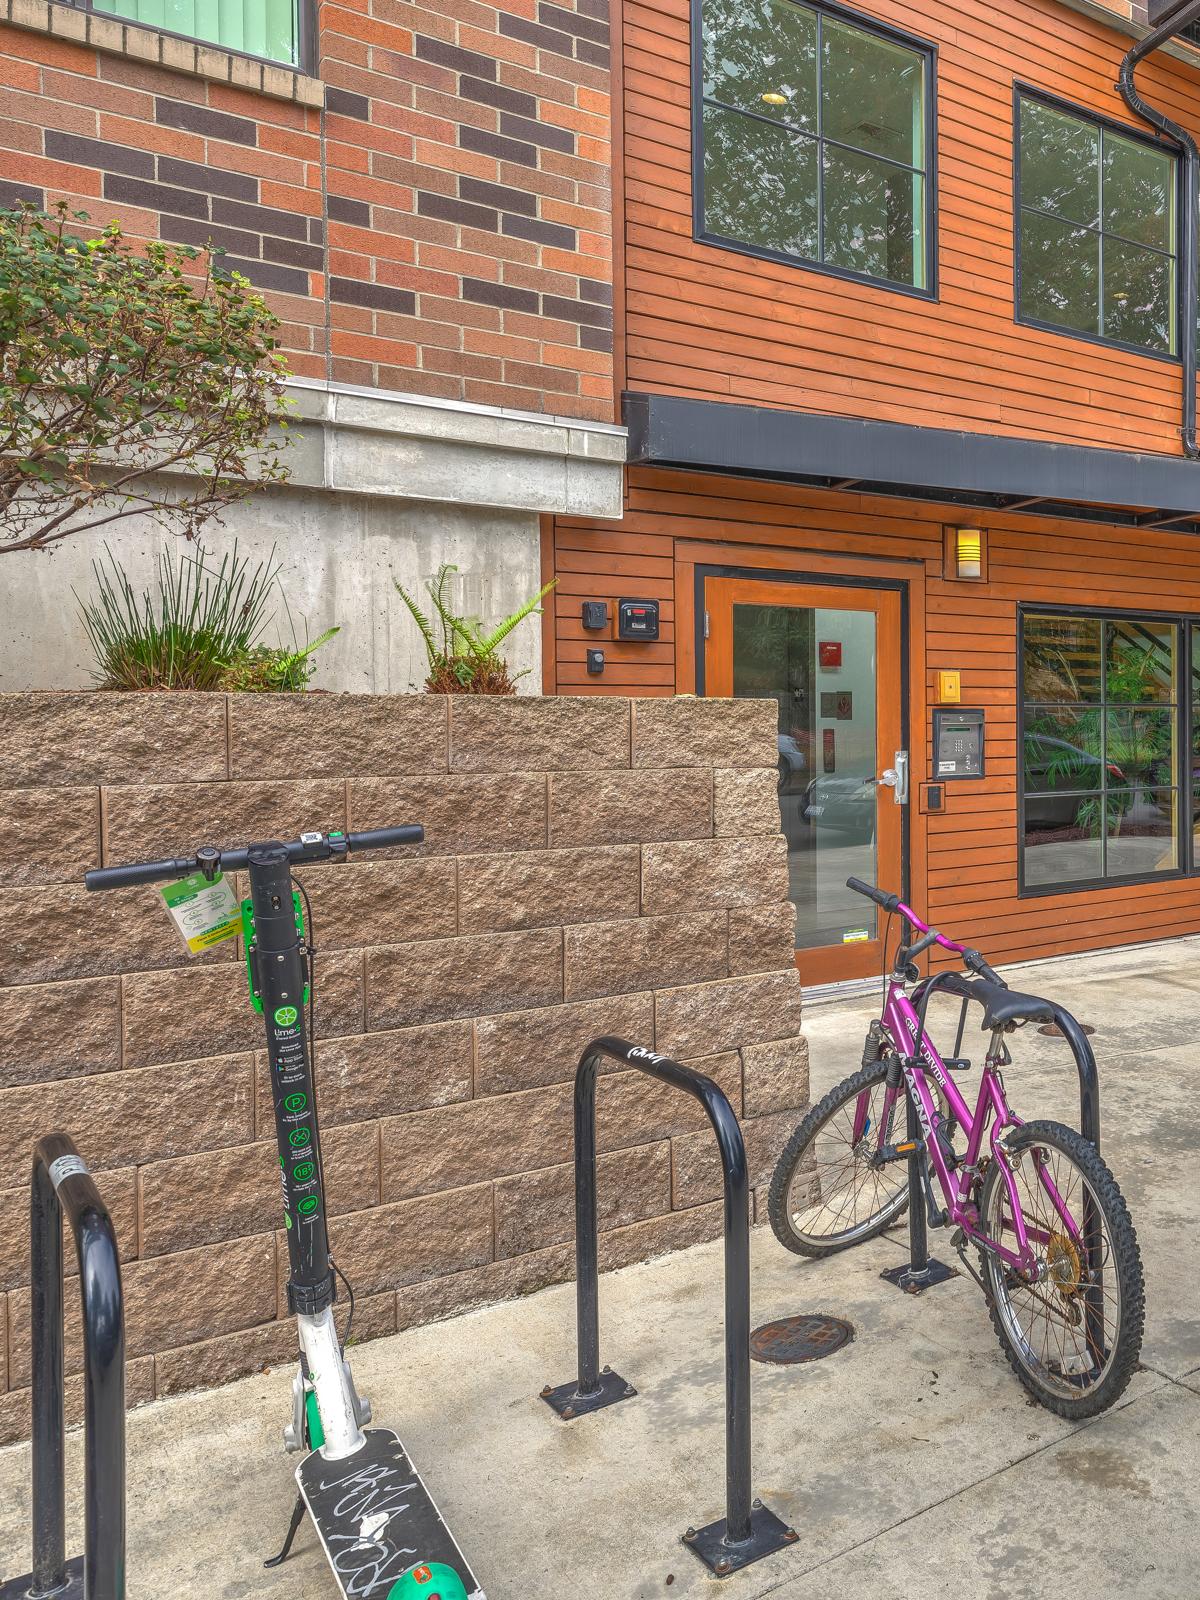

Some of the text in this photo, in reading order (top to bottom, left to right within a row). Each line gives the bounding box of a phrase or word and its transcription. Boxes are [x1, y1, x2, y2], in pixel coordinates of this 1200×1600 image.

[905, 1017, 926, 1049] GRET
[924, 1050, 947, 1088] DIVIDE
[899, 1053, 932, 1140] MAGNA
